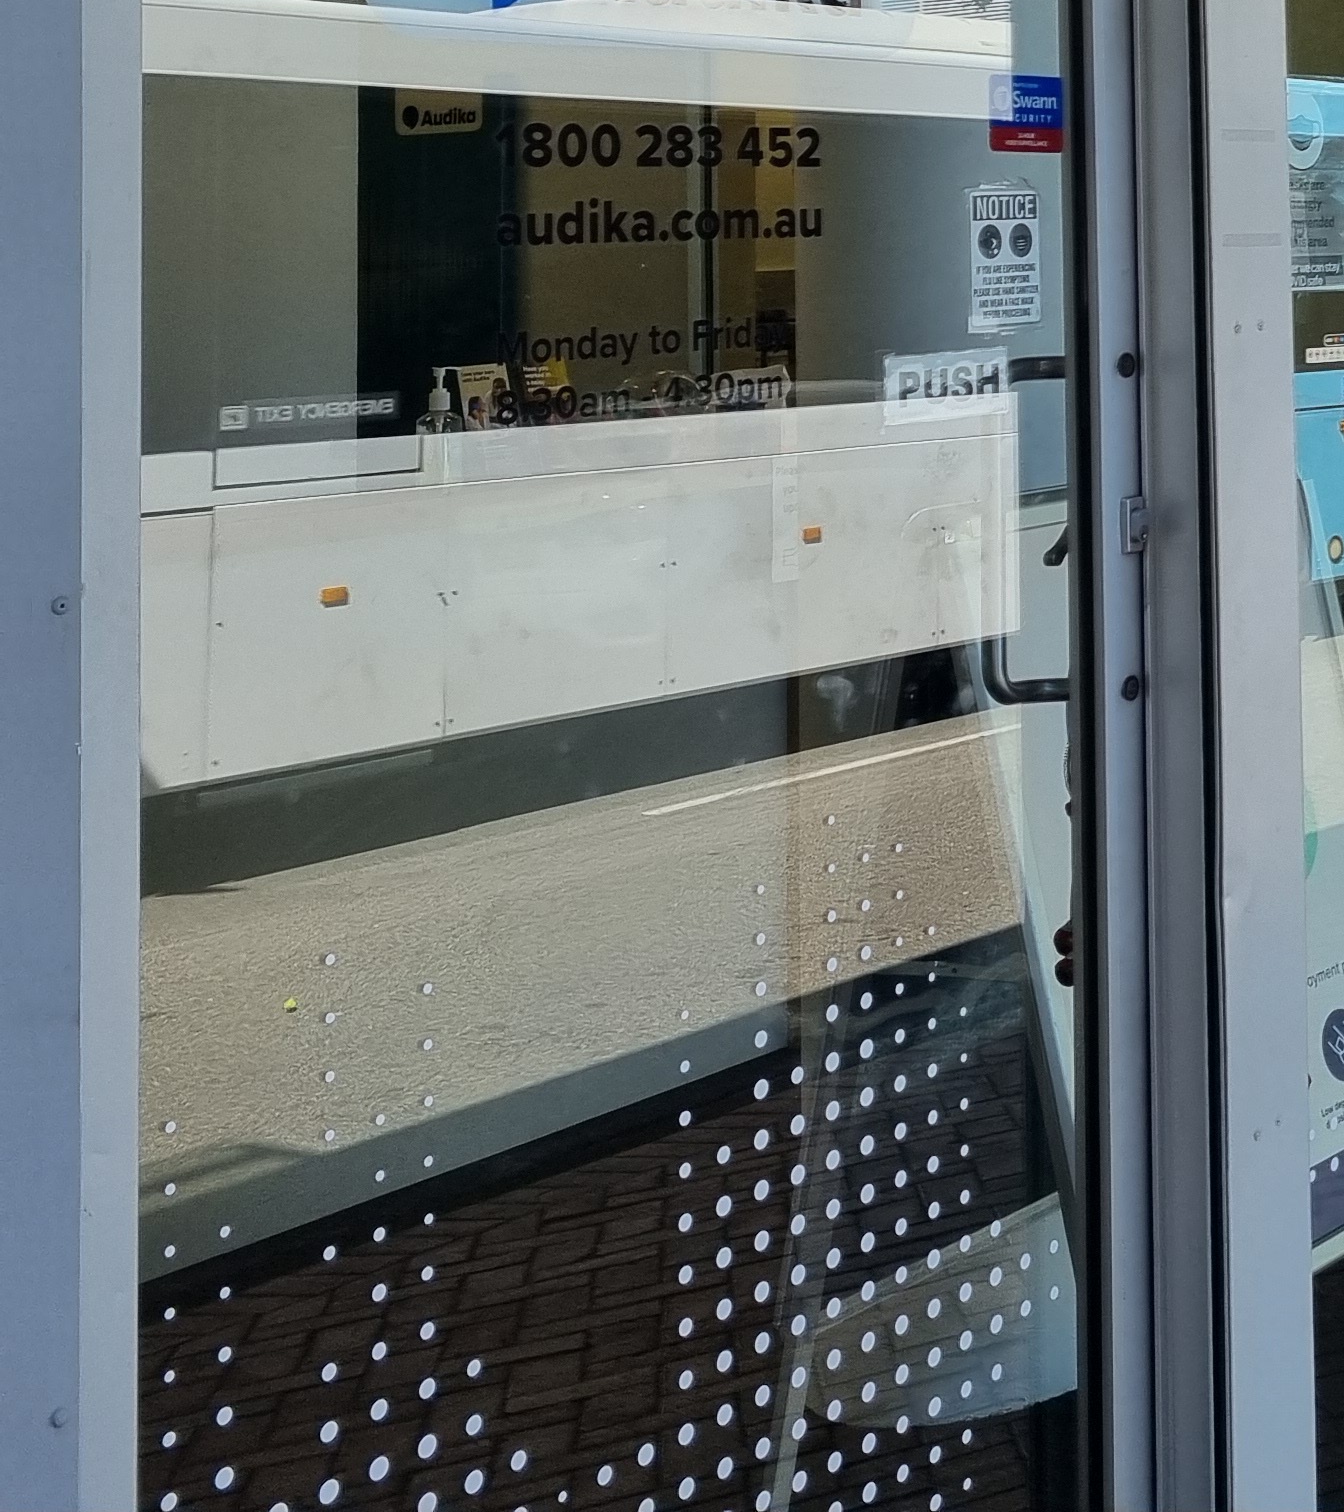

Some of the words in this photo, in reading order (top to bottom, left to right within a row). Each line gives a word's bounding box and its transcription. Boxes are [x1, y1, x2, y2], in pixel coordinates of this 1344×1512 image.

[421, 107, 477, 129] Audika
[1012, 90, 1057, 109] Swann
[634, 124, 723, 169] 283
[737, 126, 822, 168] 452
[496, 198, 824, 247] audika.com.au
[976, 195, 1035, 220] NOTICE
[499, 325, 640, 367] Monday
[648, 324, 681, 355] to
[496, 385, 631, 426] 8.30am
[898, 362, 1000, 408] PUSH
[1320, 1104, 1333, 1119] Low
